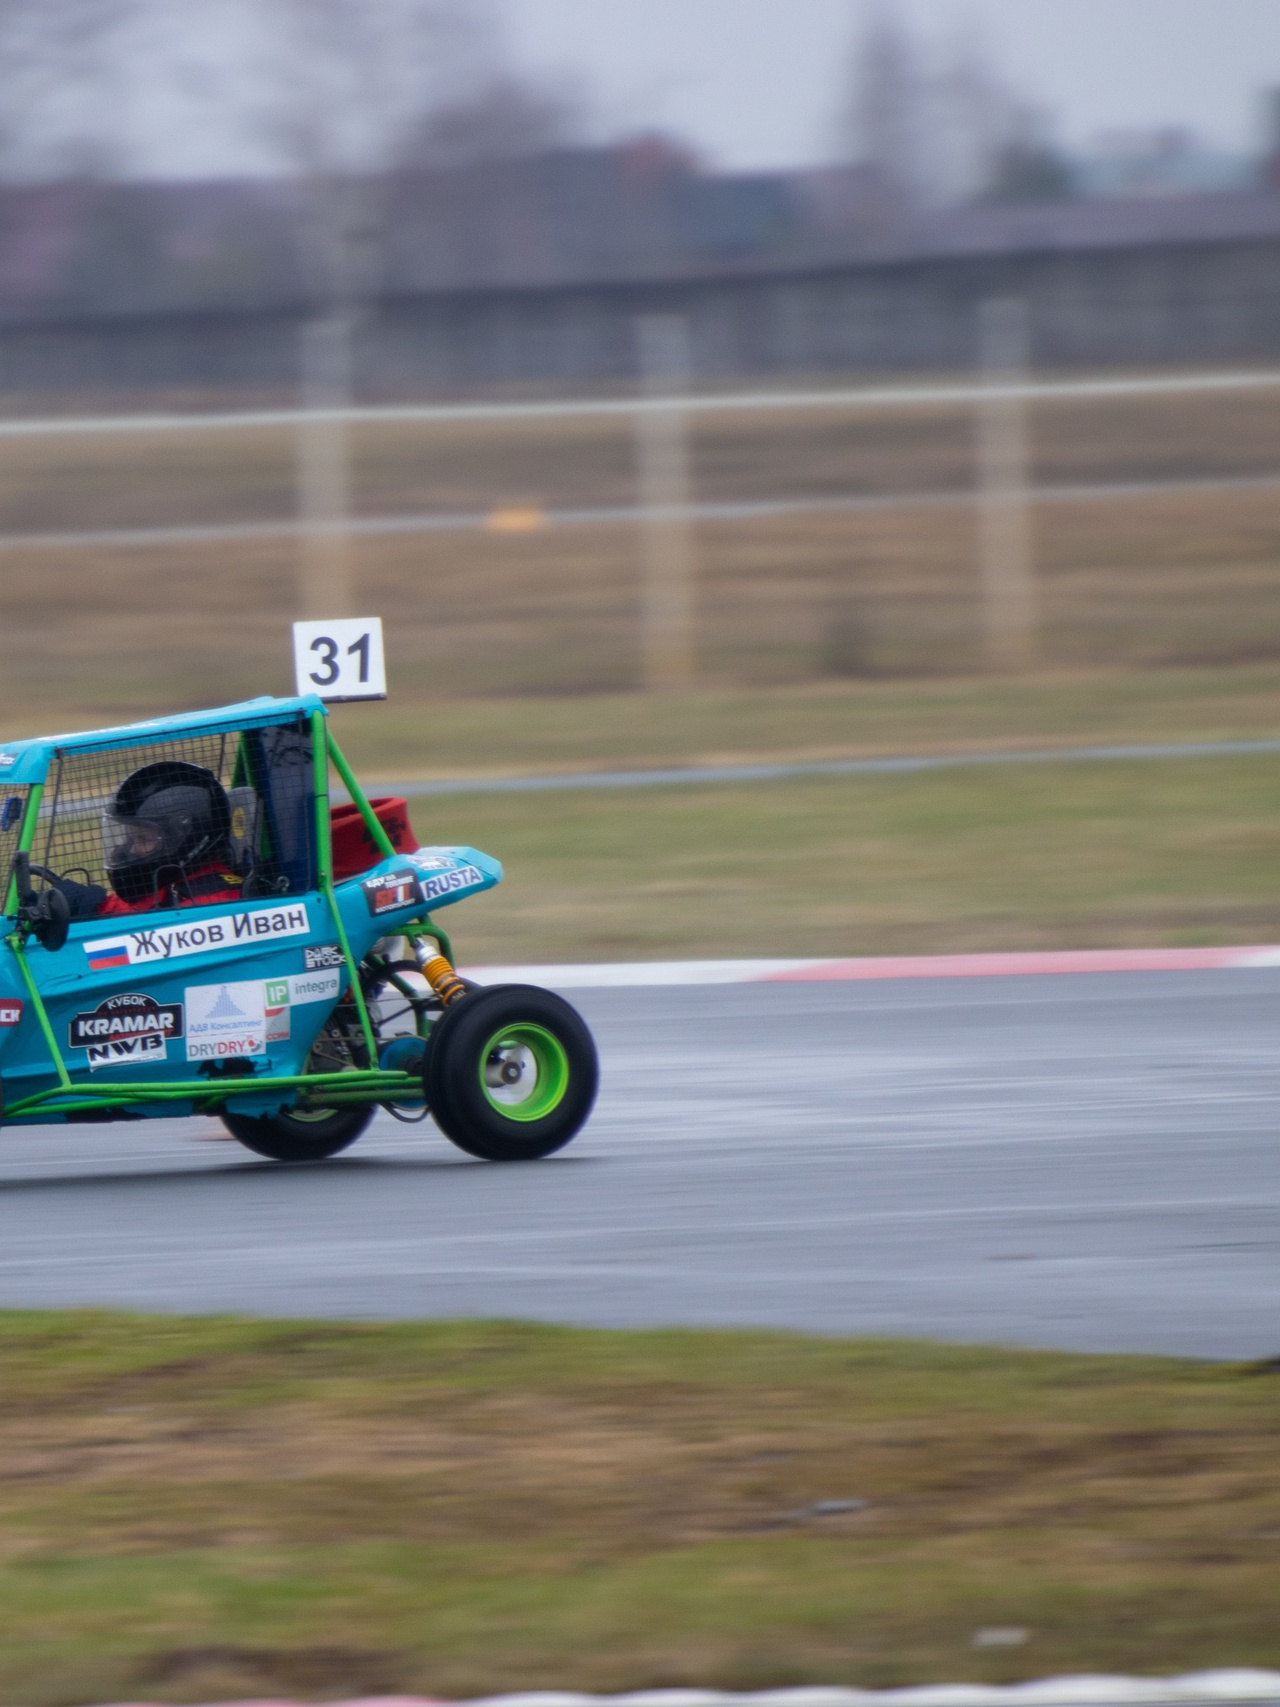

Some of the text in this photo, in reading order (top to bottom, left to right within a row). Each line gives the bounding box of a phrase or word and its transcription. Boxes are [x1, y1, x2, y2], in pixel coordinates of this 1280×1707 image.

[308, 633, 370, 687] 31
[425, 867, 482, 900] RUSTA
[131, 909, 306, 958] Жуков Иван
[107, 995, 148, 1010] КУБОК
[269, 978, 338, 1003] IP integra
[78, 1012, 175, 1037] KRAMAR
[211, 1019, 263, 1032] Консалтинг
[88, 1033, 164, 1061] NWB
[189, 1039, 246, 1058] DRYDRY
